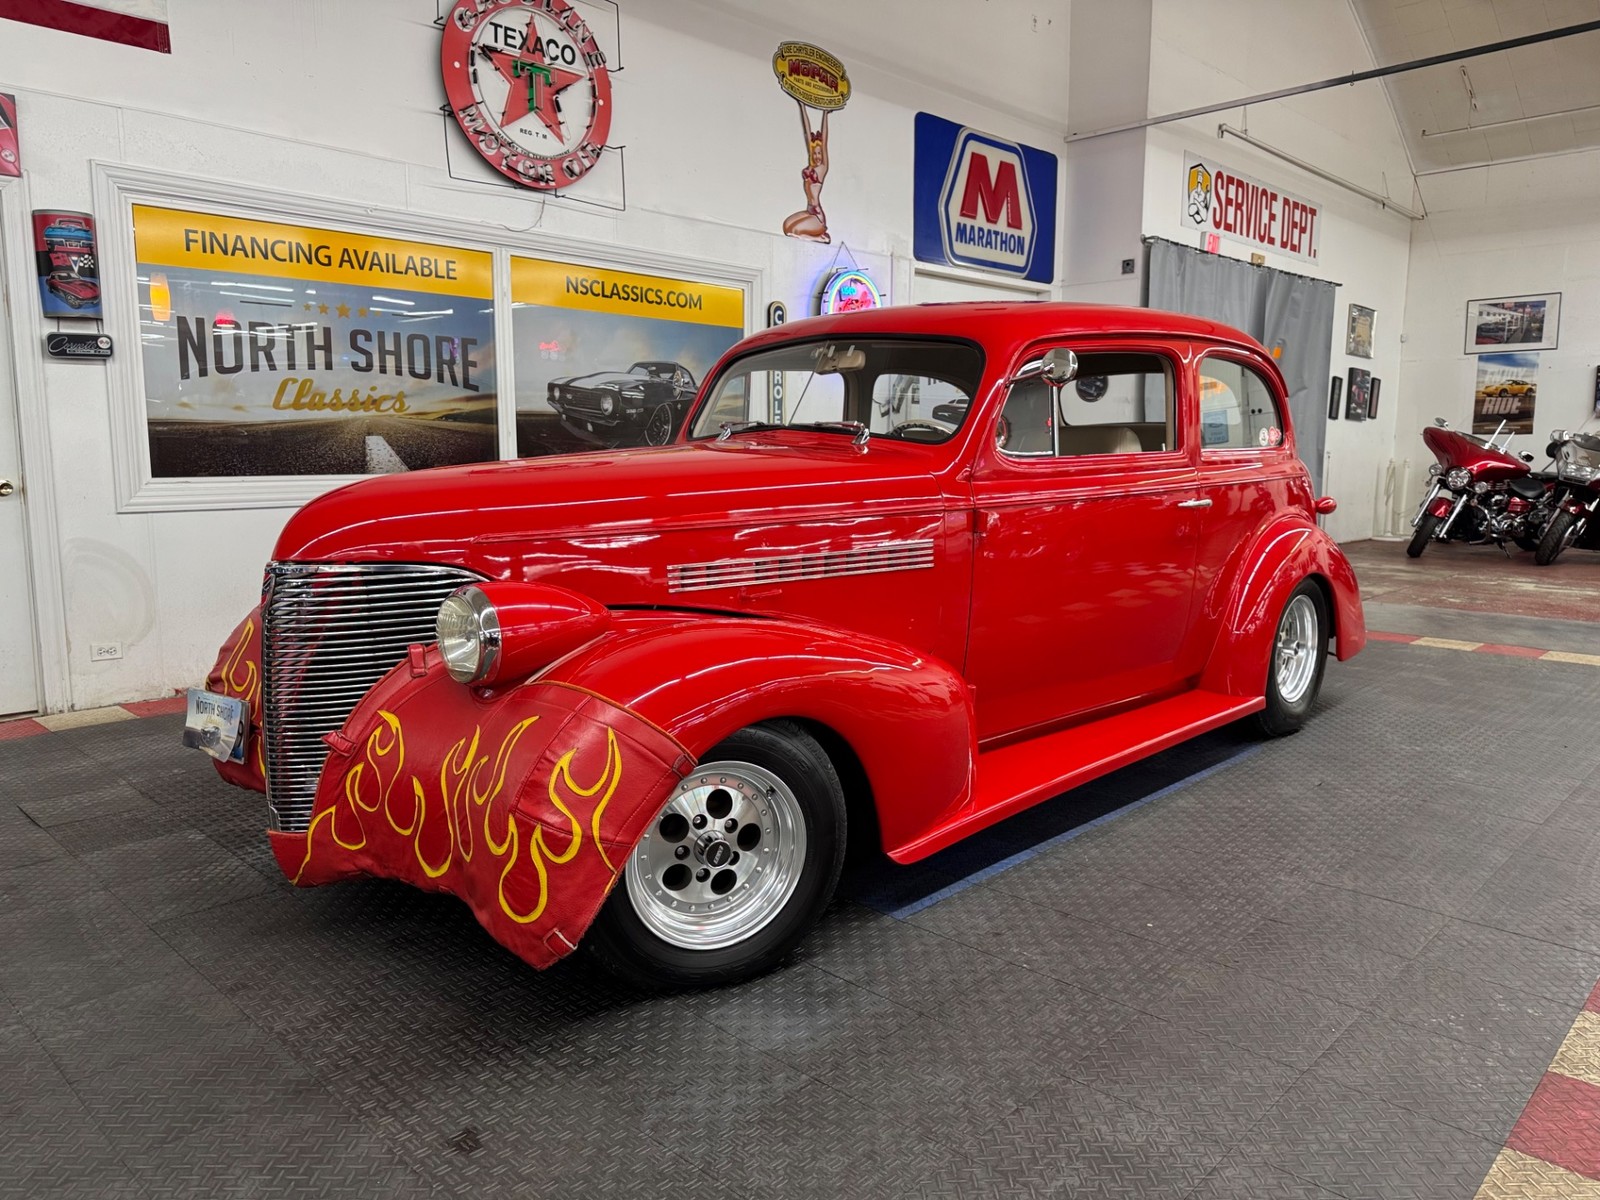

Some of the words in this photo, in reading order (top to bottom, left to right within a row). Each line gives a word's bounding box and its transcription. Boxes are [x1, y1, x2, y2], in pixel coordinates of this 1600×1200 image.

[489, 22, 576, 66] TEXACO
[793, 45, 816, 58] CHRYSLER
[959, 151, 1023, 231] M
[1212, 170, 1278, 246] SERVICE
[1280, 196, 1317, 259] DEPT.
[184, 228, 332, 267] FINANCING
[338, 248, 457, 281] AVAILABLE
[955, 222, 1025, 256] MARATHON
[566, 275, 702, 310] NSCLASSICS.COM
[176, 315, 333, 380] NORTH
[349, 328, 480, 393] SHORE
[272, 377, 411, 414] Classics
[1481, 397, 1522, 415] RIDE
